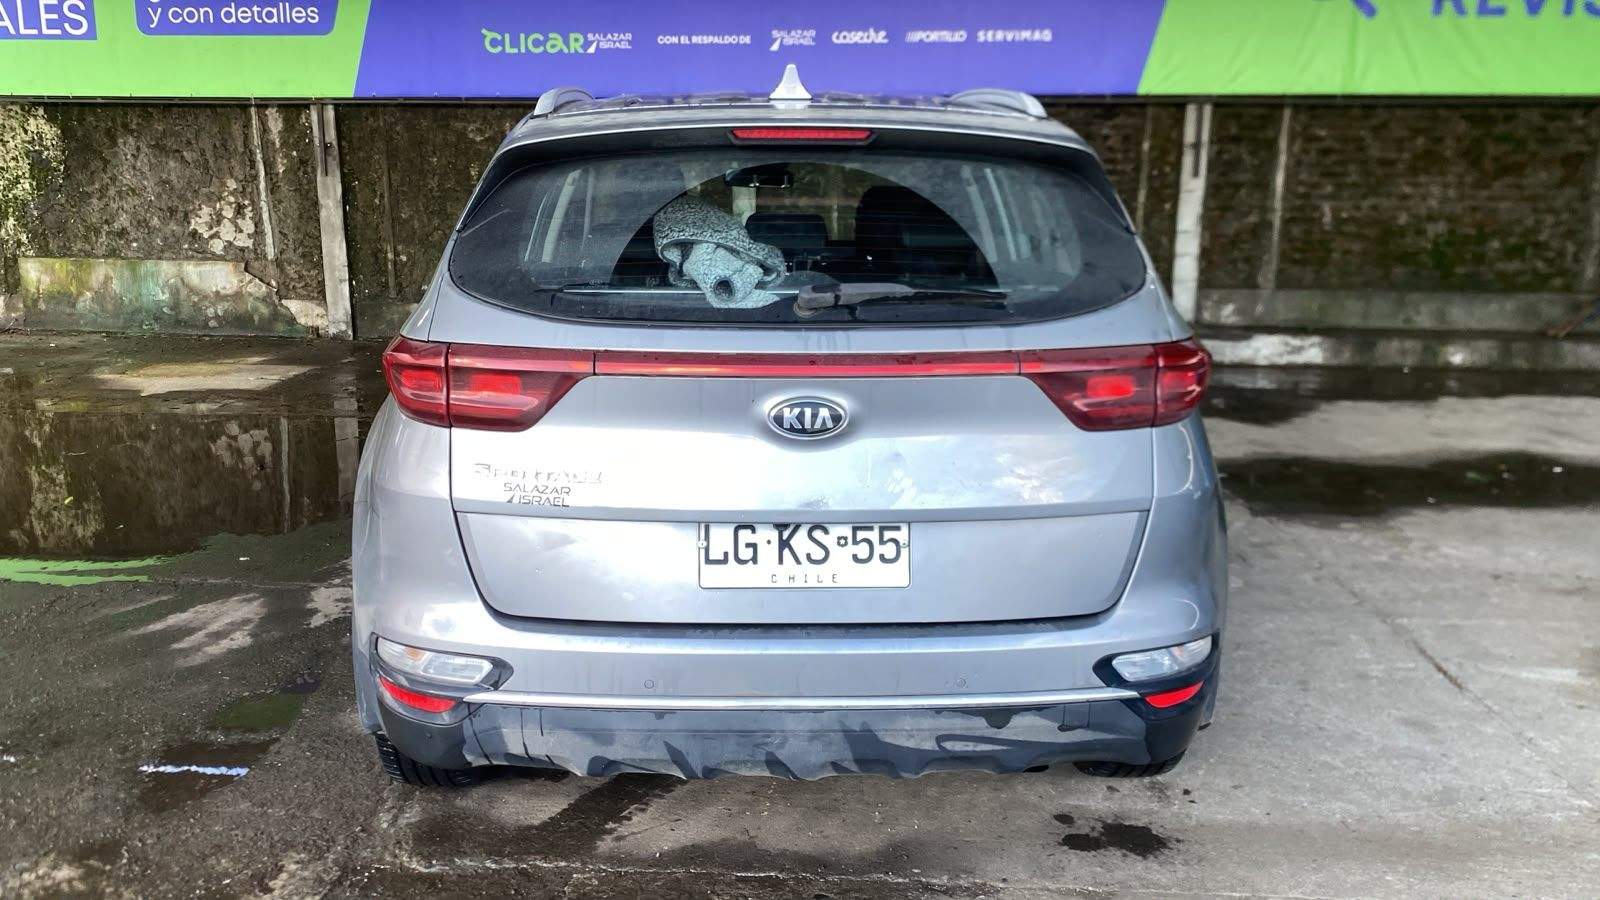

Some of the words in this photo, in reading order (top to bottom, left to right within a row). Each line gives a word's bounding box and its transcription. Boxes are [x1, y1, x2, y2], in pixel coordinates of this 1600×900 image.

[147, 7, 162, 28] y
[168, 7, 214, 24] con
[220, 2, 319, 24] detalles
[587, 32, 633, 41] SALAZAR
[657, 35, 679, 45] CON
[680, 35, 691, 45] EL
[691, 35, 738, 45] RESPALDO
[738, 35, 752, 45] DE
[598, 41, 633, 50] ISRAEL
[782, 407, 834, 429] KIA
[503, 482, 572, 496] SALAZAR
[518, 494, 570, 508] ISRAEL
[770, 573, 838, 584] CHILE
